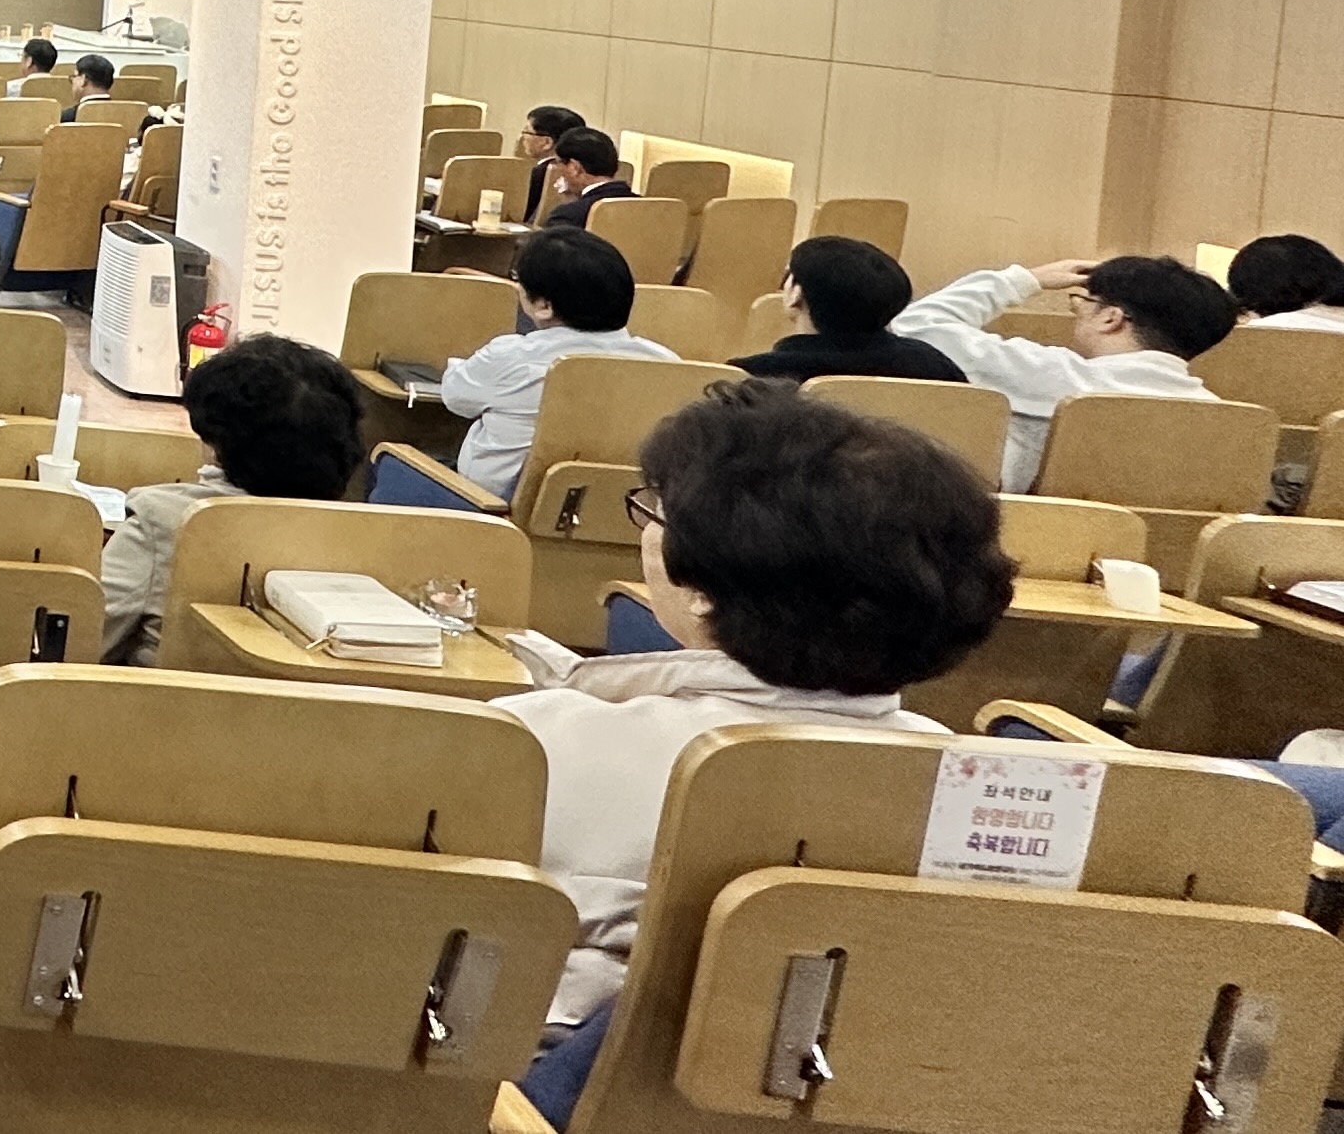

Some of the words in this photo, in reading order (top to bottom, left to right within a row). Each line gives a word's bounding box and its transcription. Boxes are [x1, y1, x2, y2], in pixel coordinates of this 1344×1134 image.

[266, 36, 302, 128] Good
[250, 228, 285, 329] JESUS
[966, 832, 1051, 857] 축복합니다
